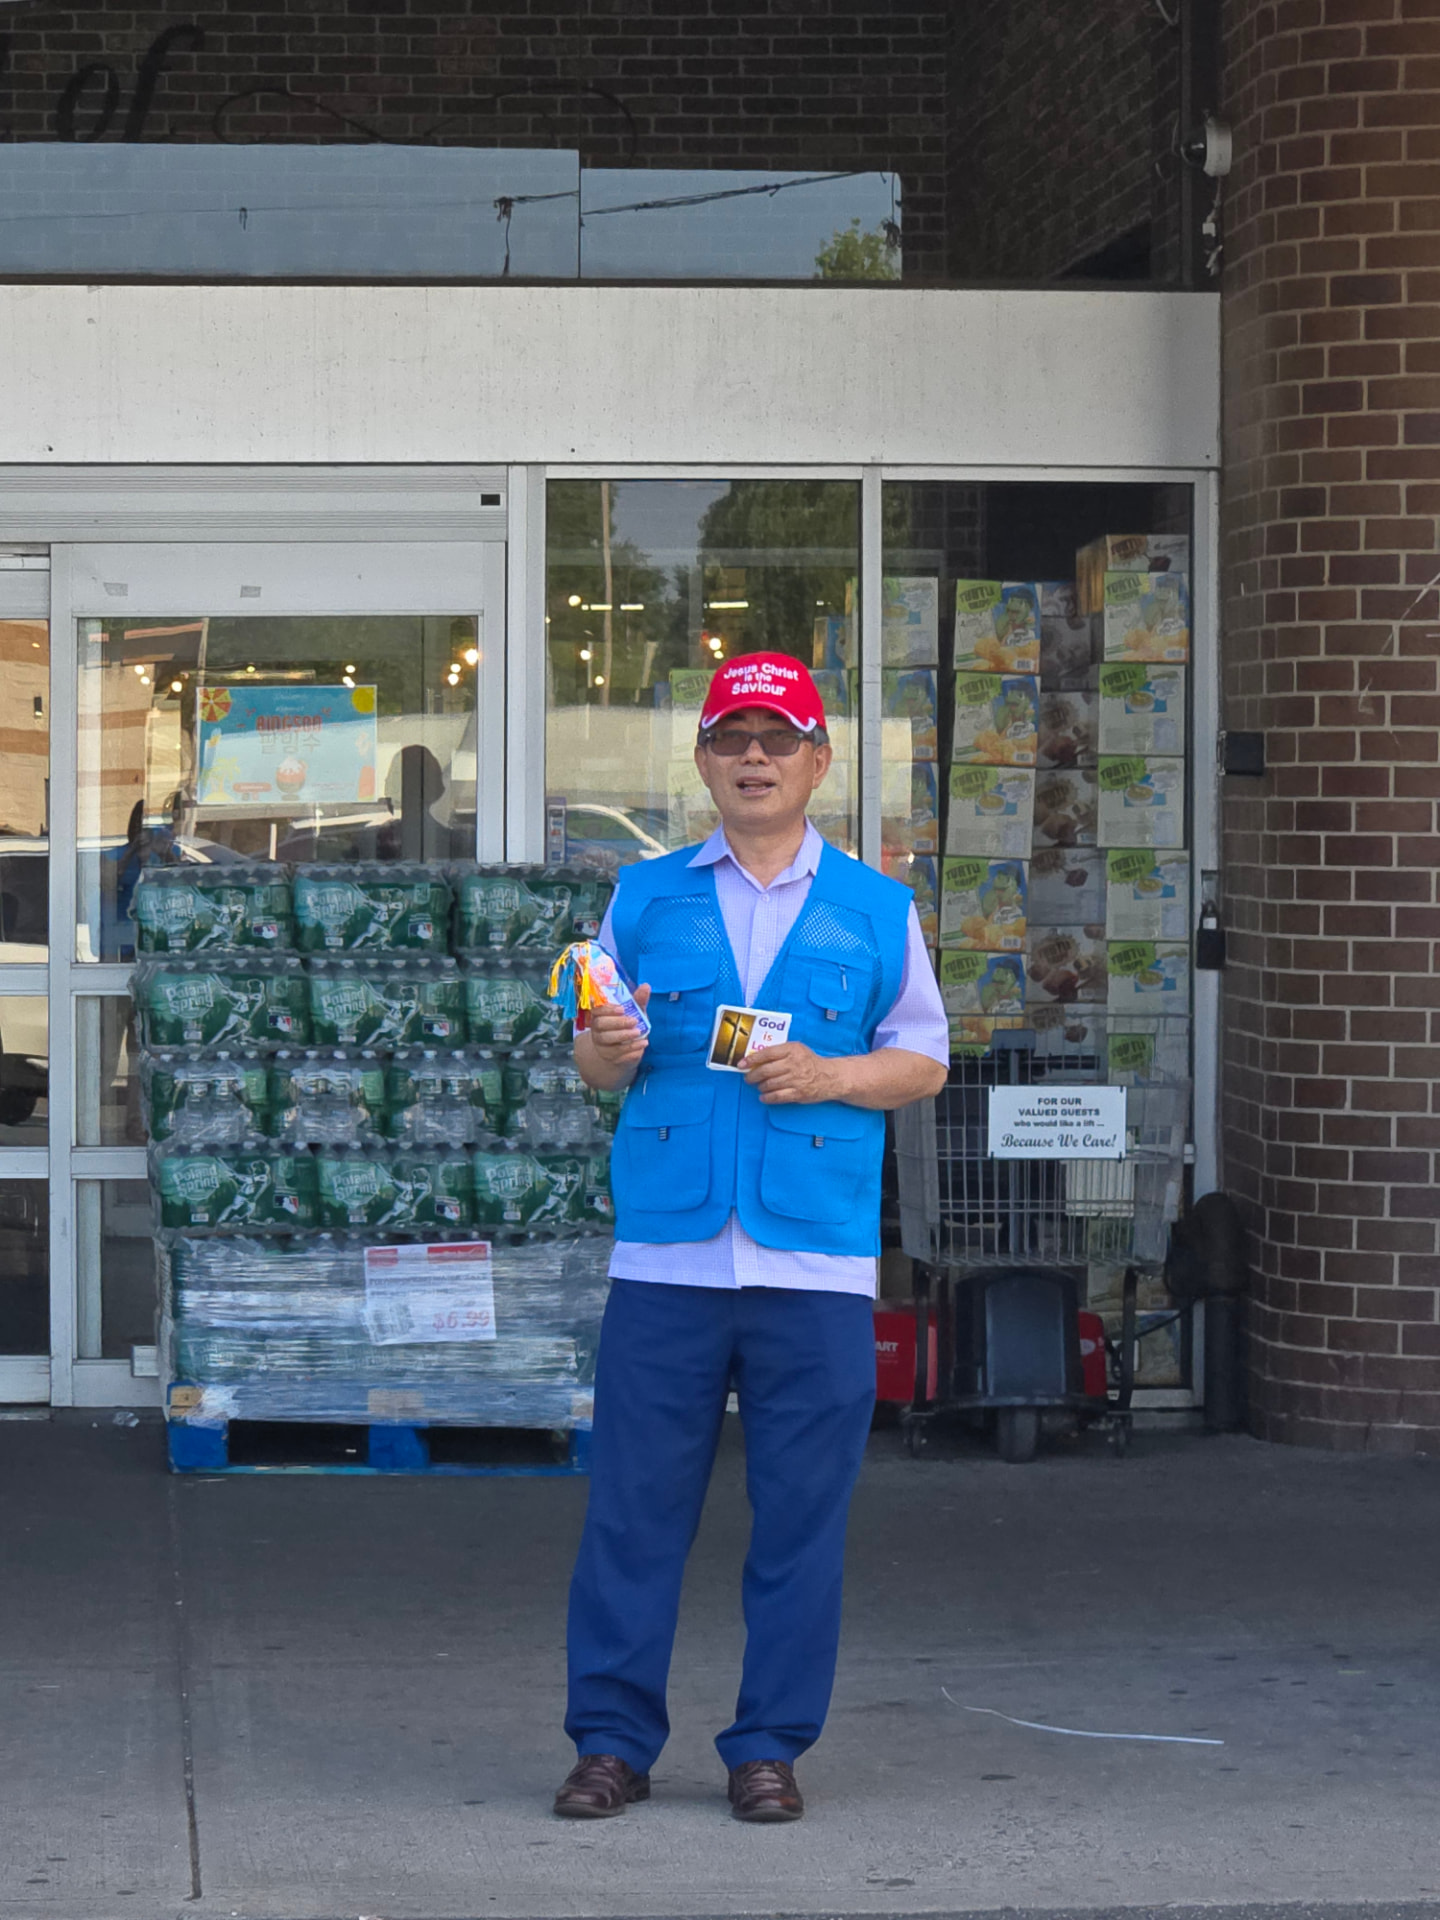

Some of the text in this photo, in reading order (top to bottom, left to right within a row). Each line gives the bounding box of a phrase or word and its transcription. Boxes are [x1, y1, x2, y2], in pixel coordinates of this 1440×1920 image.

[723, 662, 799, 681] Jesus Christ
[744, 671, 772, 682] is the
[731, 681, 786, 696] Saviour
[758, 1017, 786, 1031] God
[763, 1031, 773, 1041] is
[1037, 1097, 1082, 1105] FOR OUR
[1018, 1108, 1100, 1116] VALUED GUESTS
[1001, 1133, 1117, 1148] Because We Care!
[173, 1164, 218, 1186] Poland
[333, 1166, 377, 1187] Poland
[486, 1162, 531, 1181] Poland
[176, 1176, 220, 1198] Spring
[489, 1174, 533, 1195] Spring
